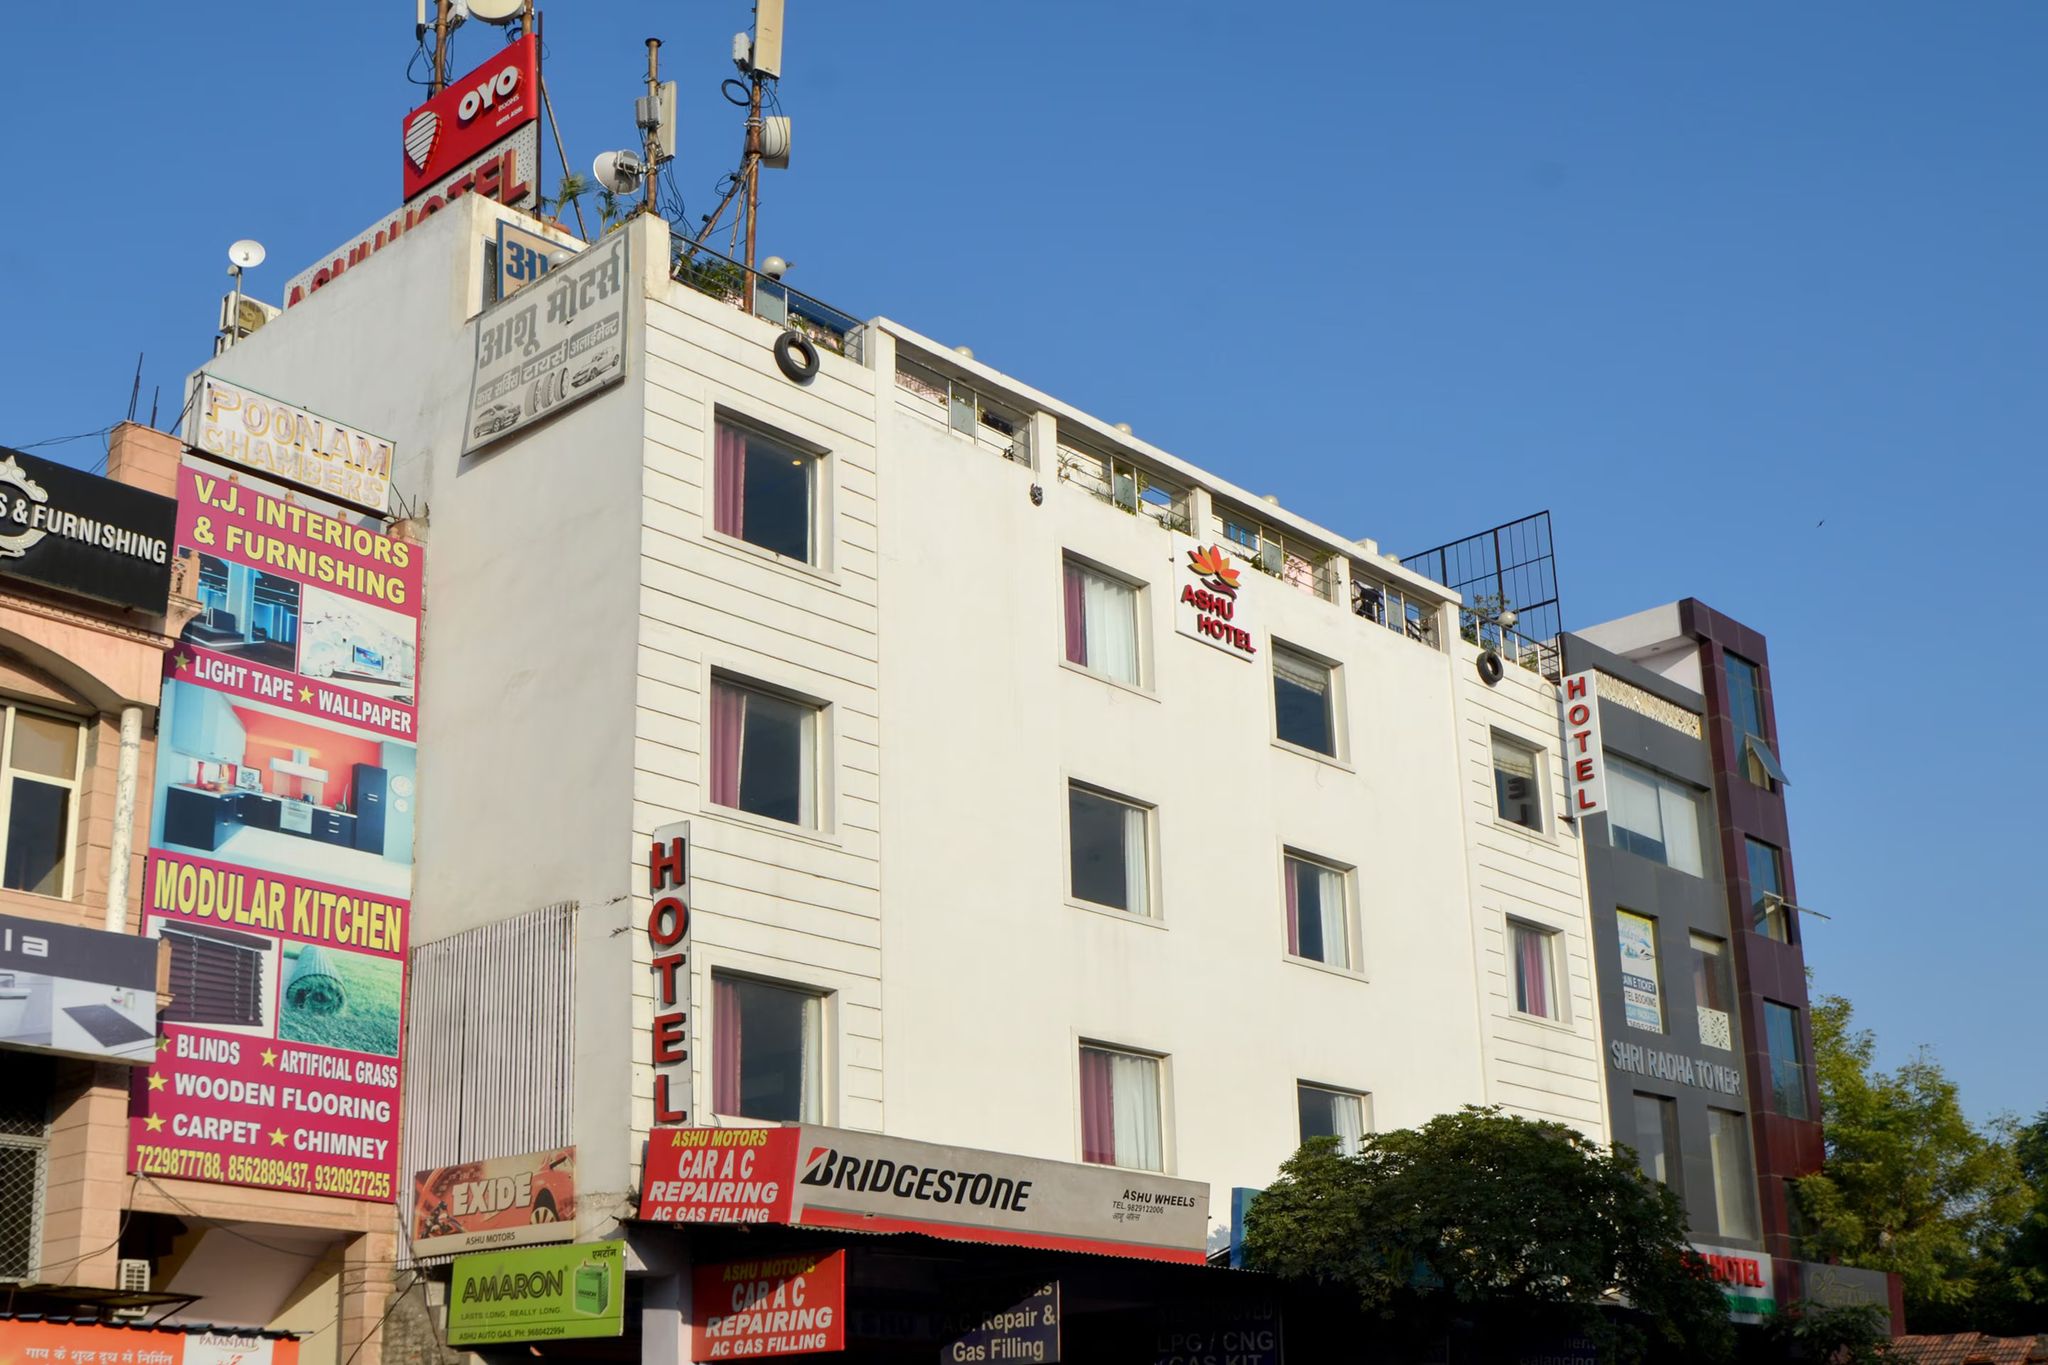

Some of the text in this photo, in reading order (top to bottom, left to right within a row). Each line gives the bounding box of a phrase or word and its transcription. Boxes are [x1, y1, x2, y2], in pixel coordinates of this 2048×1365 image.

[459, 66, 518, 120] OYO
[547, 240, 622, 324] मोटर्स
[206, 382, 391, 481] POONAM
[201, 424, 385, 509] CHAMBERS
[12, 498, 28, 525] &
[33, 504, 167, 565] FURNISHING
[194, 474, 410, 569] V.J. INTERIORS
[193, 516, 215, 546] &
[226, 525, 406, 605] FURNISHING
[1181, 584, 1234, 621] ASHU
[1197, 613, 1257, 654] HOTEL
[194, 655, 294, 702] LIGHT TAPE
[318, 688, 412, 733] WALLPAPER
[1567, 676, 1597, 809] HOTEL
[153, 859, 402, 954] MODULAR KITCHEN
[649, 837, 687, 1123] HOTEL
[177, 1034, 240, 1065] BLINDS
[280, 1050, 398, 1088] ARTIFICIAL GRASS
[1611, 1040, 1741, 1095] SHRI RADHA TOWER
[174, 1073, 391, 1123] WOODEN FLOORING
[172, 1114, 261, 1145] CARPET
[293, 1129, 388, 1160] CHIMNEY
[672, 1129, 768, 1147] ASHU MOTORS
[315, 1165, 390, 1198] 9320927255
[678, 1150, 719, 1179] CAR
[800, 1147, 1032, 1212] BRIDGESTONE
[453, 1172, 534, 1217] EXIDE
[649, 1181, 779, 1204] REPAIRING
[1123, 1189, 1195, 1207] ASHU WHEELS
[652, 1207, 769, 1222] AC GAS FILLING
[466, 1232, 516, 1245] ASHU MOTORS
[462, 1269, 564, 1304] AMARON
[723, 1256, 816, 1282] ASHU MOTORS
[509, 1308, 537, 1318] REALLY
[540, 1307, 561, 1315] LONG
[732, 1280, 768, 1313] CAR
[478, 1330, 496, 1340] AUTO
[705, 1307, 833, 1338] REPAIRING
[981, 1306, 1038, 1334] Repair
[1042, 1304, 1056, 1326] &
[710, 1333, 826, 1356] AC GAS FILLING
[953, 1337, 1044, 1363] Gas Filling
[1223, 1331, 1275, 1352] CNG
